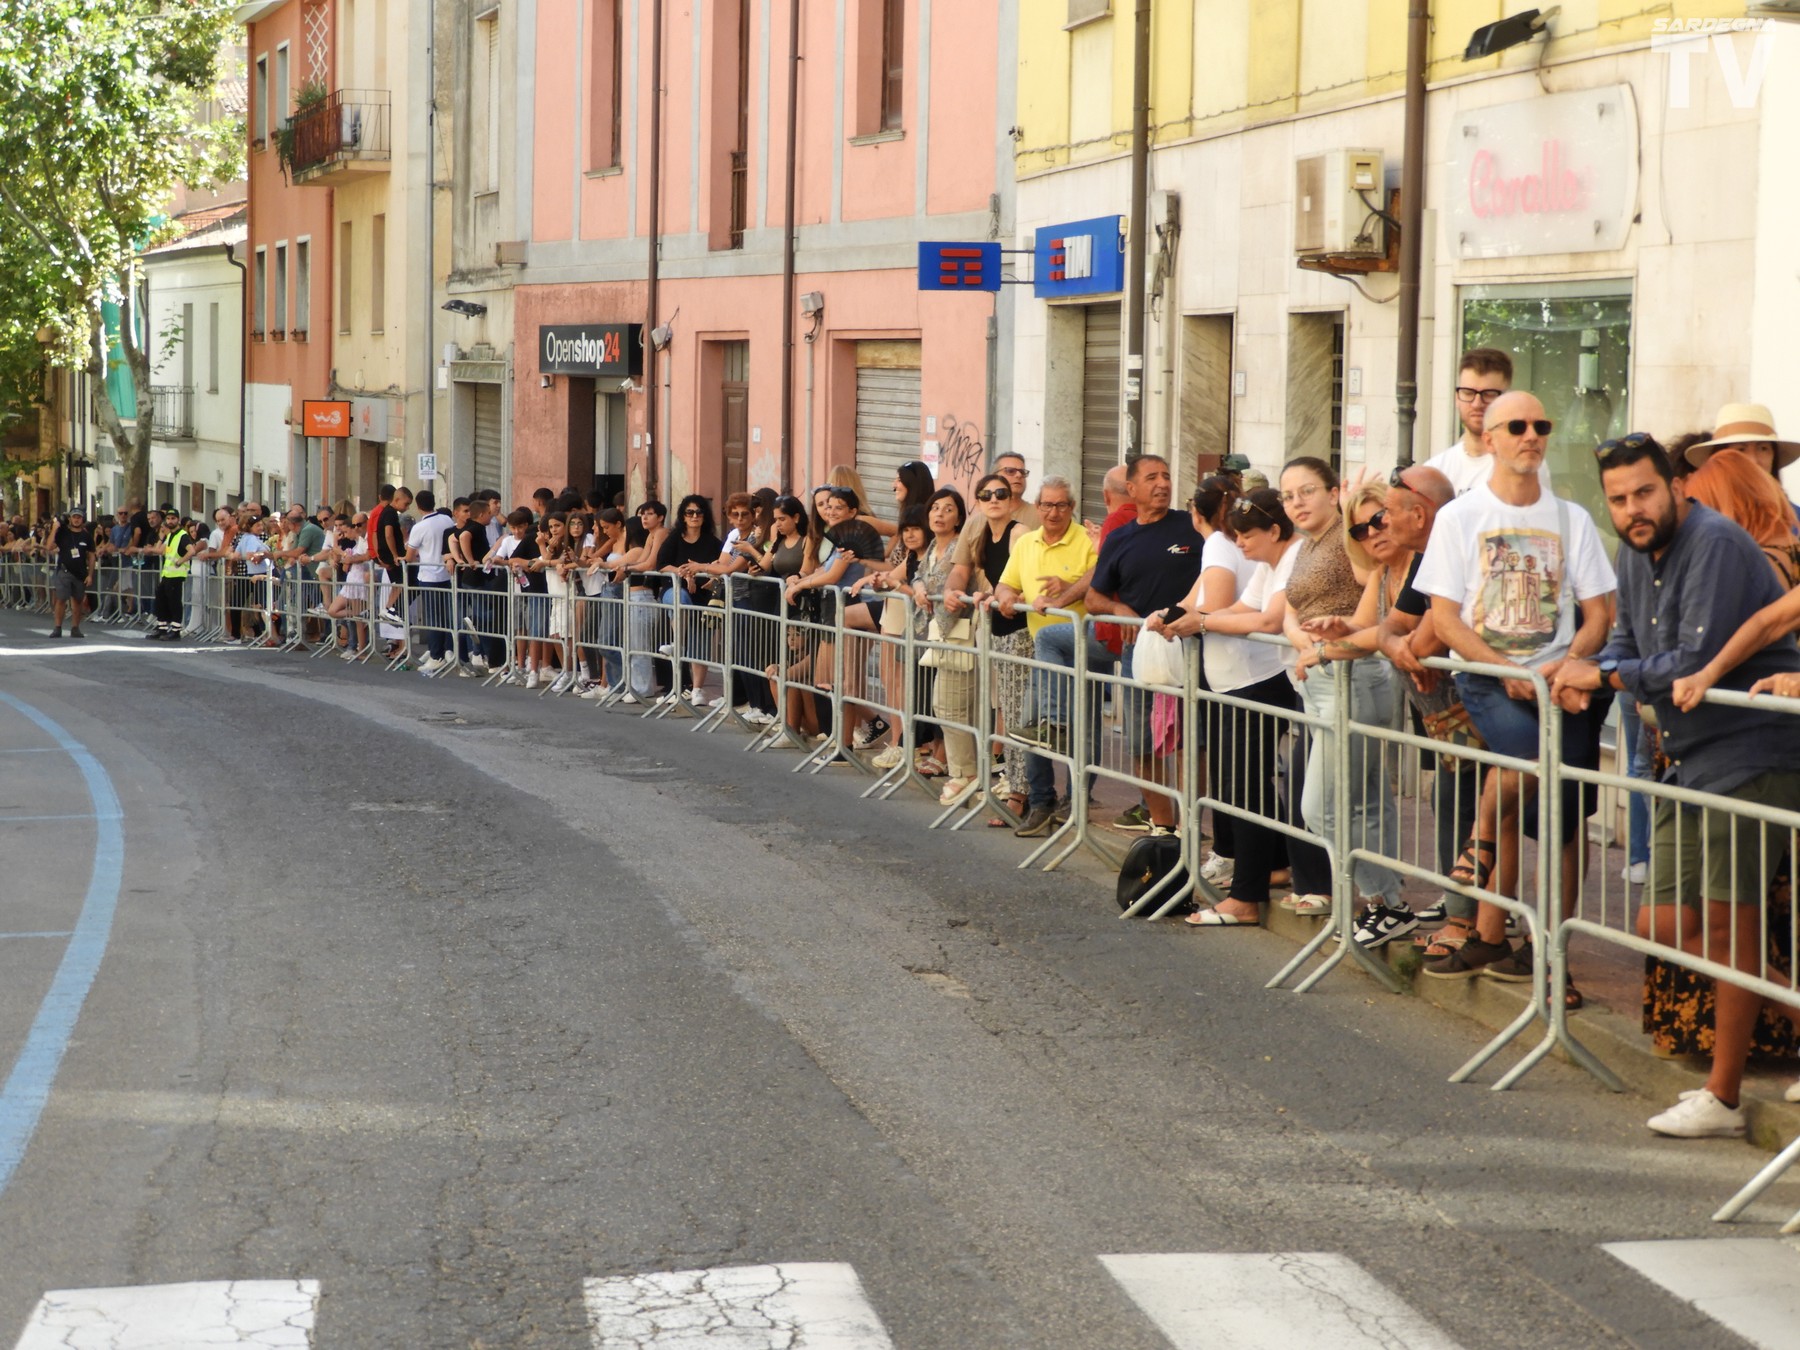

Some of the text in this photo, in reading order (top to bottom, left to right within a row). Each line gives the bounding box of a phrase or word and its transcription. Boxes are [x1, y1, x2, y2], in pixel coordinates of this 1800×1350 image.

[1469, 139, 1578, 219] Corallo
[1063, 234, 1092, 279] TIM
[546, 331, 620, 370] Openshop24
